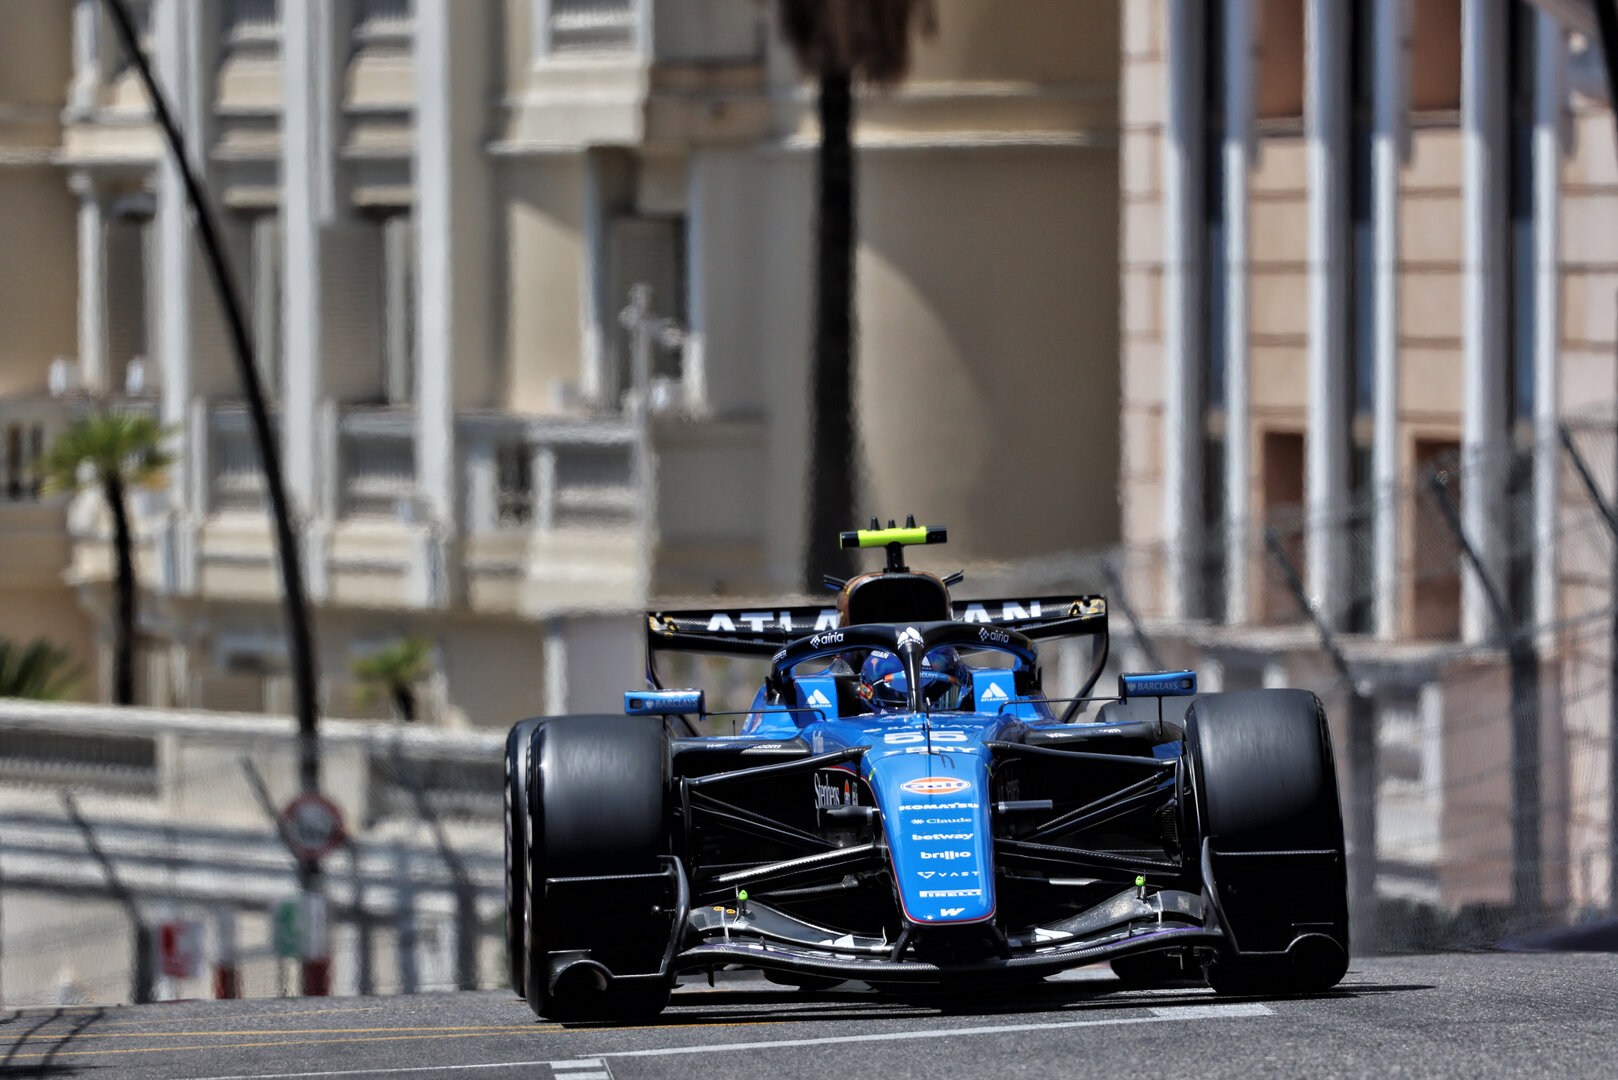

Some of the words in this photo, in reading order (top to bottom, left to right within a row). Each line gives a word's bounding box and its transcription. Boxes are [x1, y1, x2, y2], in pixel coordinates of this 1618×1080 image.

[820, 631, 844, 644] airia
[990, 630, 1010, 644] airia
[1137, 681, 1178, 690] BARCLAYS
[655, 699, 698, 708] BARCLAYS
[884, 731, 968, 744] 55
[898, 802, 980, 811] KOMATSU
[912, 832, 974, 841] betway
[920, 850, 972, 860] brillio
[919, 889, 983, 898] PIRELLI
